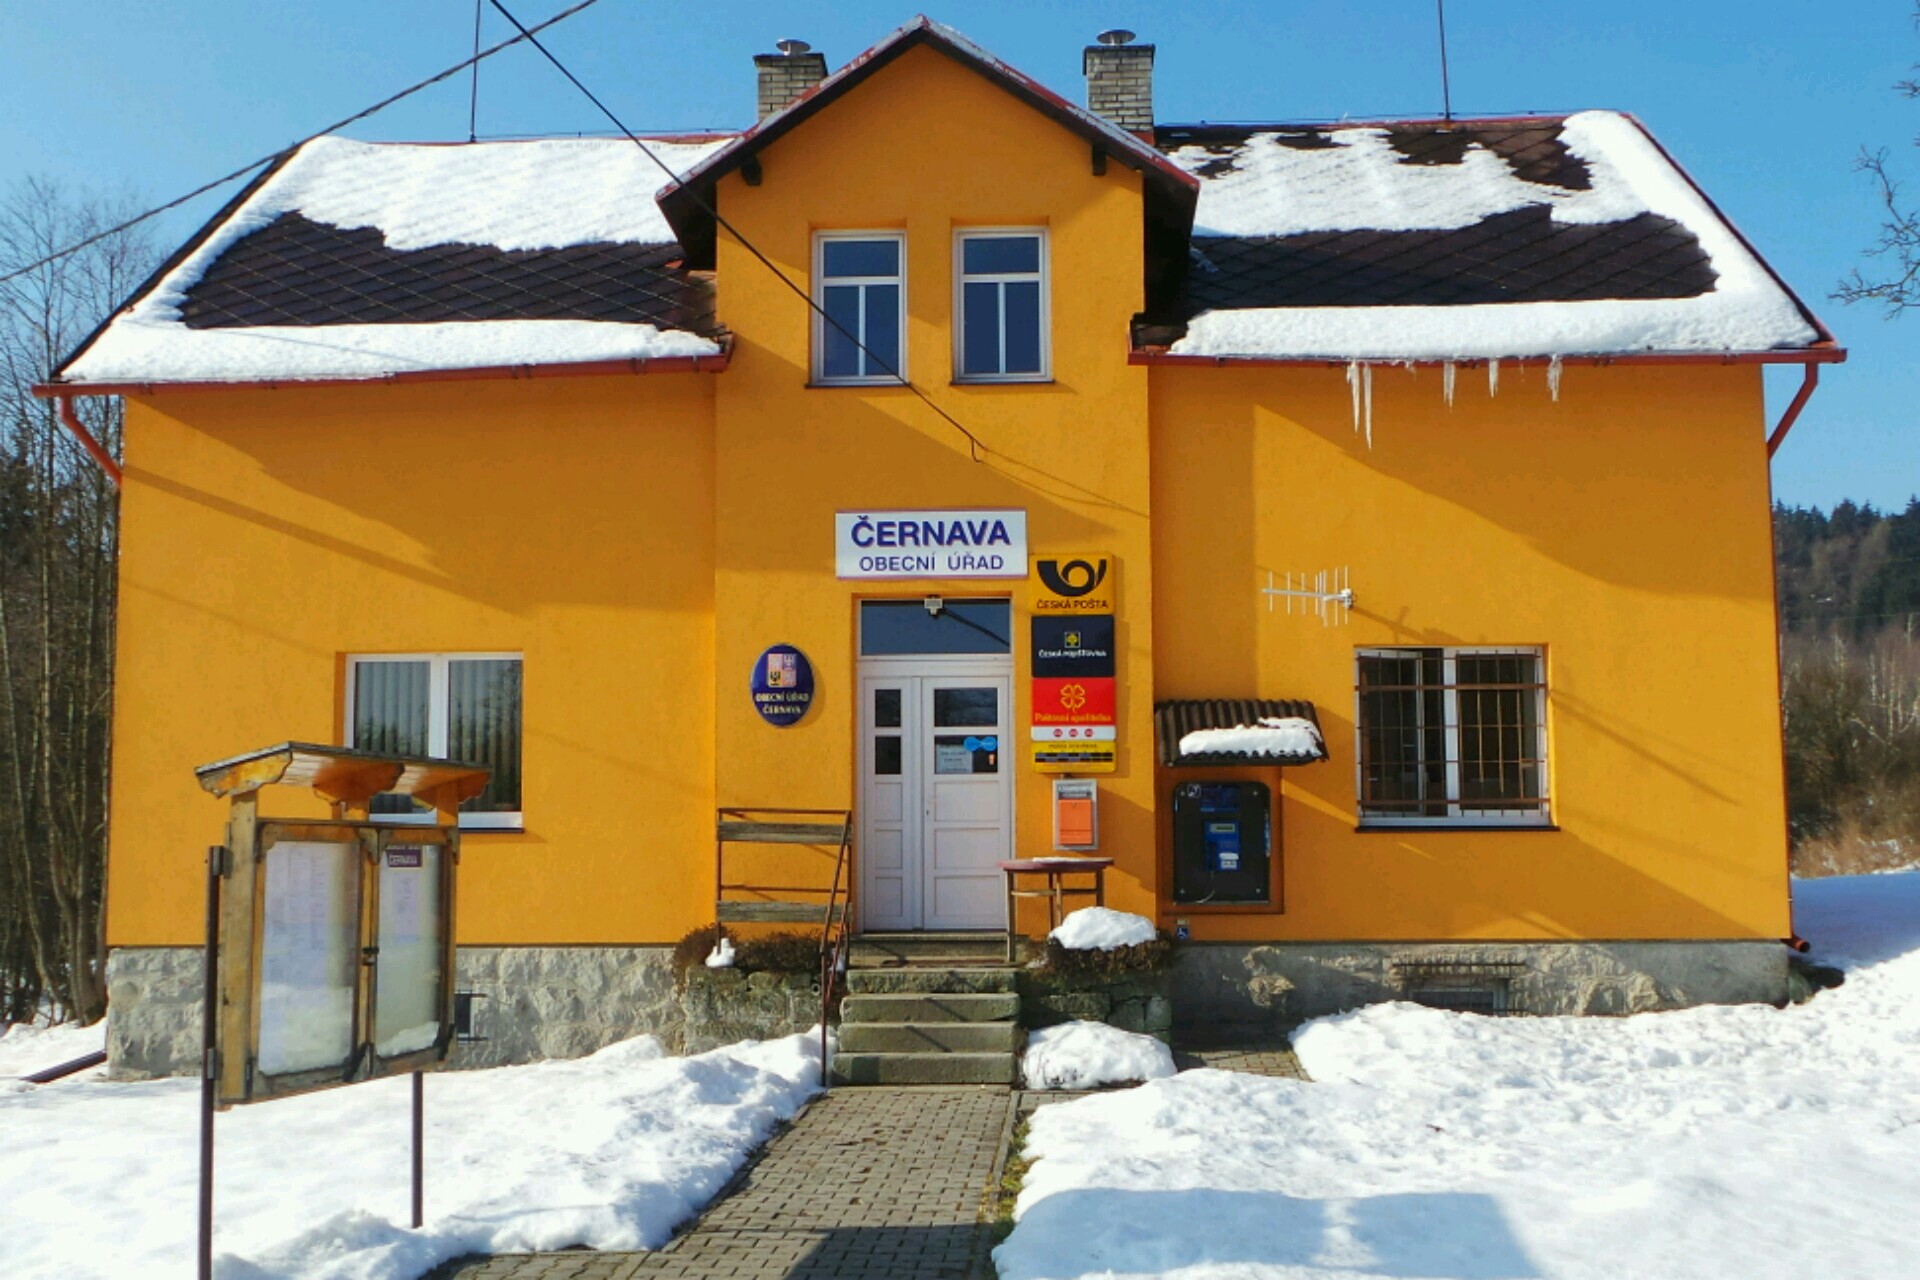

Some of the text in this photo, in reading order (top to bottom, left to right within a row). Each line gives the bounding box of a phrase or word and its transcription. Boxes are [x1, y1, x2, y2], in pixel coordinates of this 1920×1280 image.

[851, 515, 1011, 548] ČERNAVA
[859, 551, 1004, 572] OBECNÍ ÚŘAD
[1036, 598, 1109, 609] ČESKÁ POŠTA
